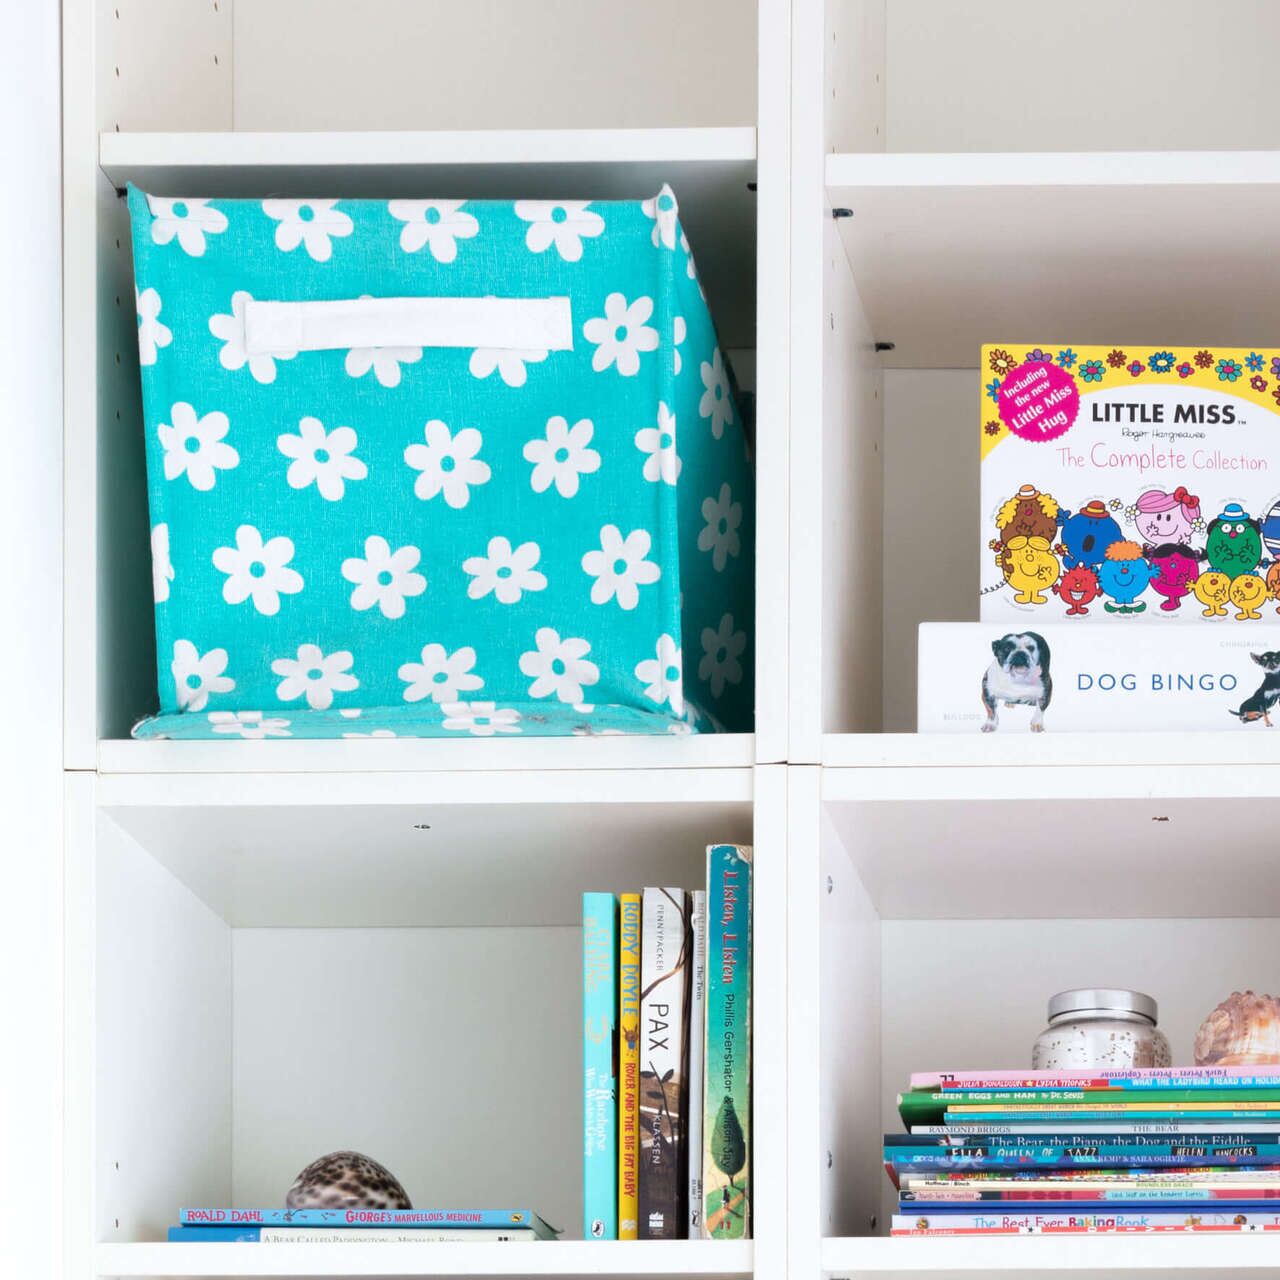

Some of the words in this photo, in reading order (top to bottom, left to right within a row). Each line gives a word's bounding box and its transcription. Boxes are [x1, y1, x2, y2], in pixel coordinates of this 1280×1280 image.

[1003, 366, 1048, 399] Including
[1015, 393, 1030, 408] the
[1030, 379, 1051, 400] new
[1012, 405, 1044, 430] Little
[1045, 385, 1073, 410] Miss
[1092, 403, 1164, 423] LITTLE
[1174, 404, 1237, 425] MISS
[1038, 411, 1068, 434] Hug
[1056, 446, 1085, 468] The
[1090, 442, 1187, 474] Complete
[1192, 449, 1268, 470] Collection
[1077, 673, 1137, 692] DOG
[1151, 673, 1239, 692] BINGO
[720, 870, 739, 927] Listen,
[622, 901, 639, 957] RODDY
[722, 932, 738, 984] Listen
[622, 963, 639, 1017] DOYLE
[648, 1004, 670, 1051] PAX
[624, 1062, 637, 1090] ROVER
[624, 1092, 636, 1112] AND
[932, 1092, 961, 1100] GREEN
[969, 1092, 992, 1100] EGGS
[1014, 1092, 1036, 1100] HAM
[624, 1114, 636, 1132] THE
[624, 1134, 636, 1151] BIG
[623, 1152, 636, 1169] FAT
[623, 1171, 636, 1198] BABY
[187, 1210, 226, 1222] ROALD
[231, 1210, 264, 1223] DAHL
[345, 1210, 392, 1224] GEORGE'S
[394, 1211, 444, 1223] MARVELLOUS
[446, 1211, 483, 1223] MEDICINE
